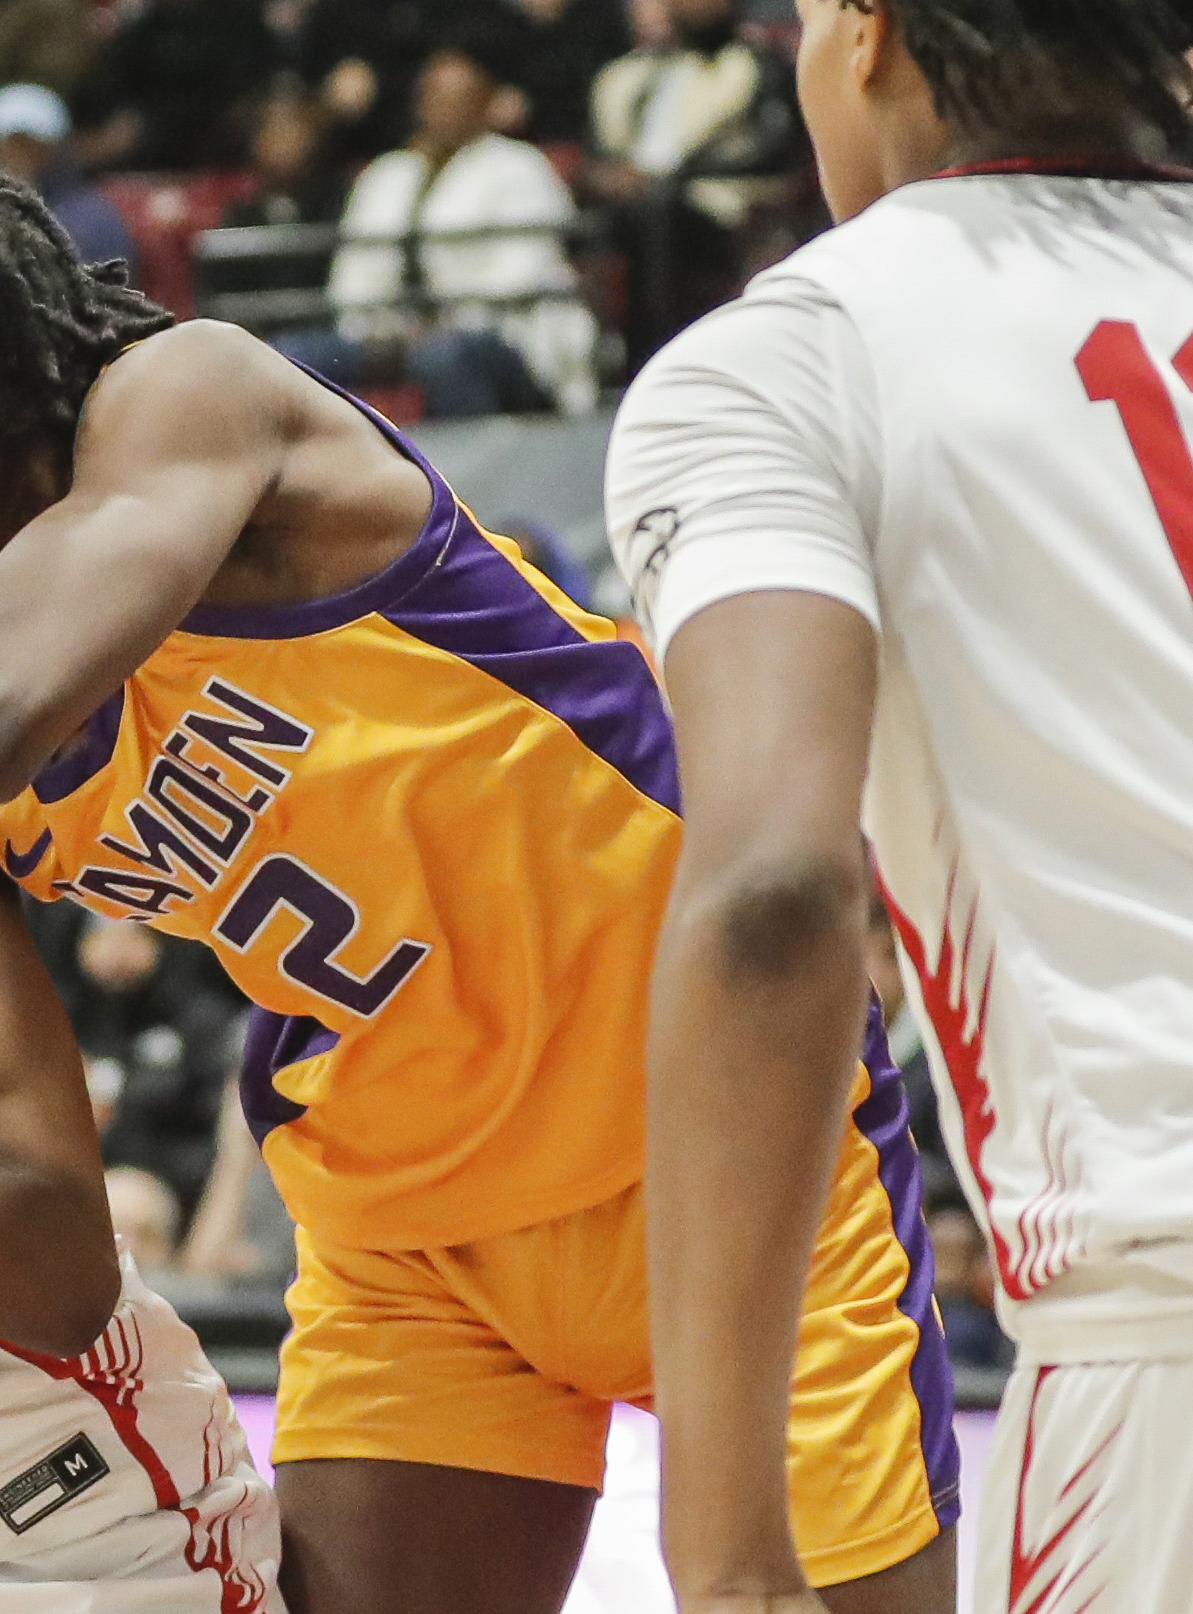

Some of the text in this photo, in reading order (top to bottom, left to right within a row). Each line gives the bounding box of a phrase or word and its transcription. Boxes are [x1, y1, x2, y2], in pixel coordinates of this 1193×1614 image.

[1073, 318, 1193, 612] 1
[51, 676, 314, 923] AMDEN
[211, 853, 433, 1020] 2
[64, 1453, 88, 1476] M
